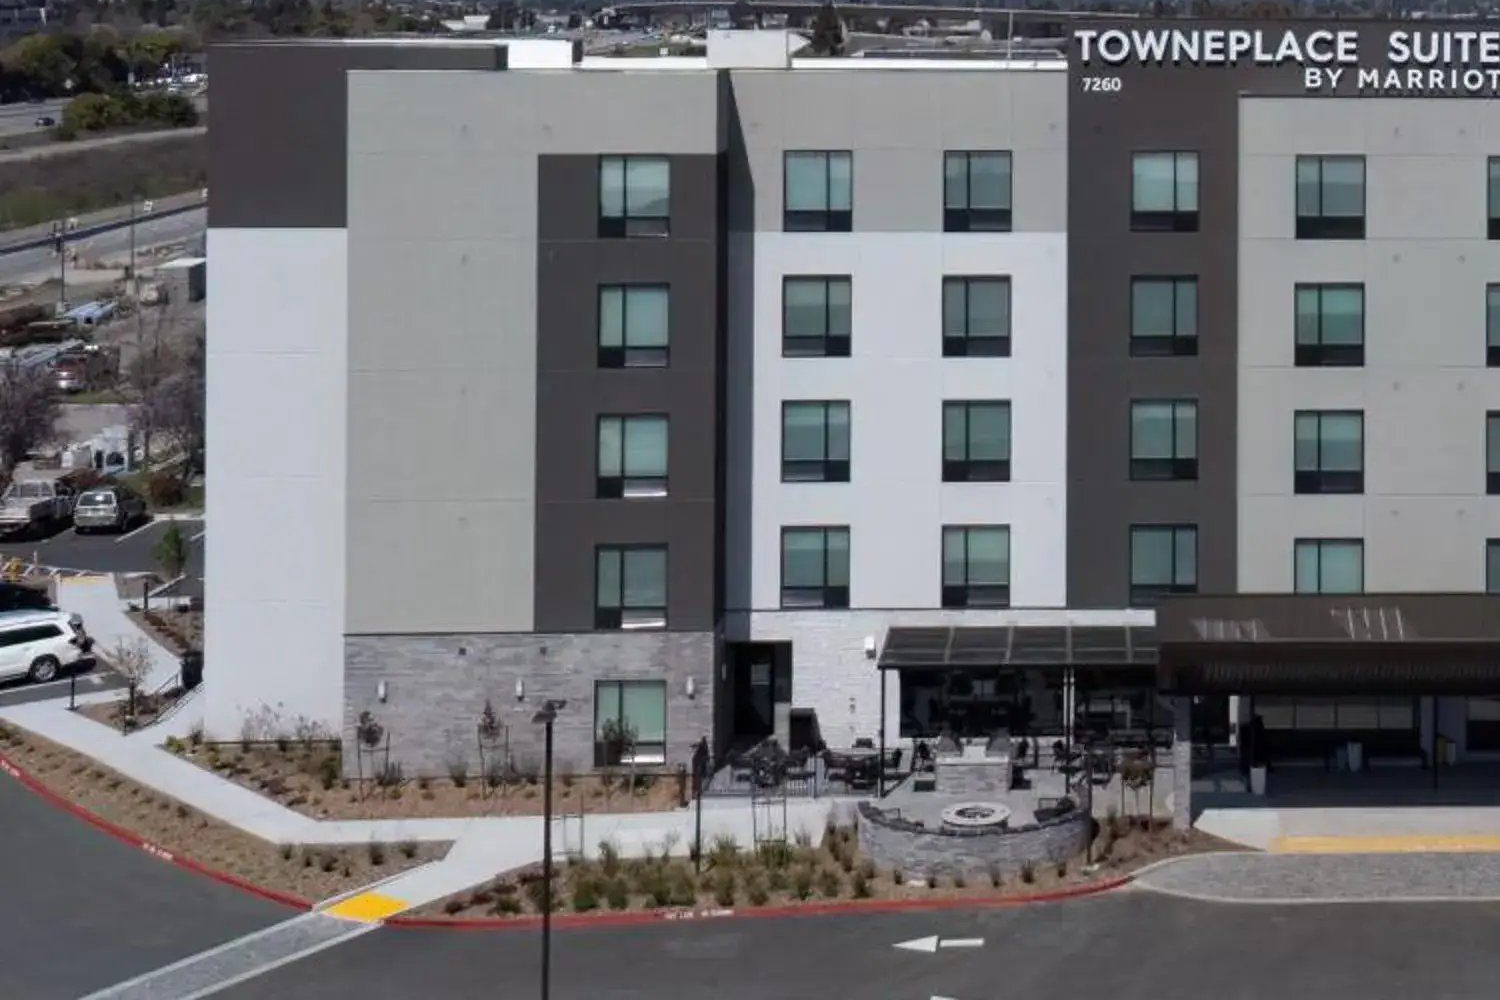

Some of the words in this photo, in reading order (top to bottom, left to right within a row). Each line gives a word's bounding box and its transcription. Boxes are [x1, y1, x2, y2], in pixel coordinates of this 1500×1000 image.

[1073, 29, 1358, 62] TOWNEPLACE
[1081, 76, 1122, 92] 7260
[1304, 67, 1344, 89] BY
